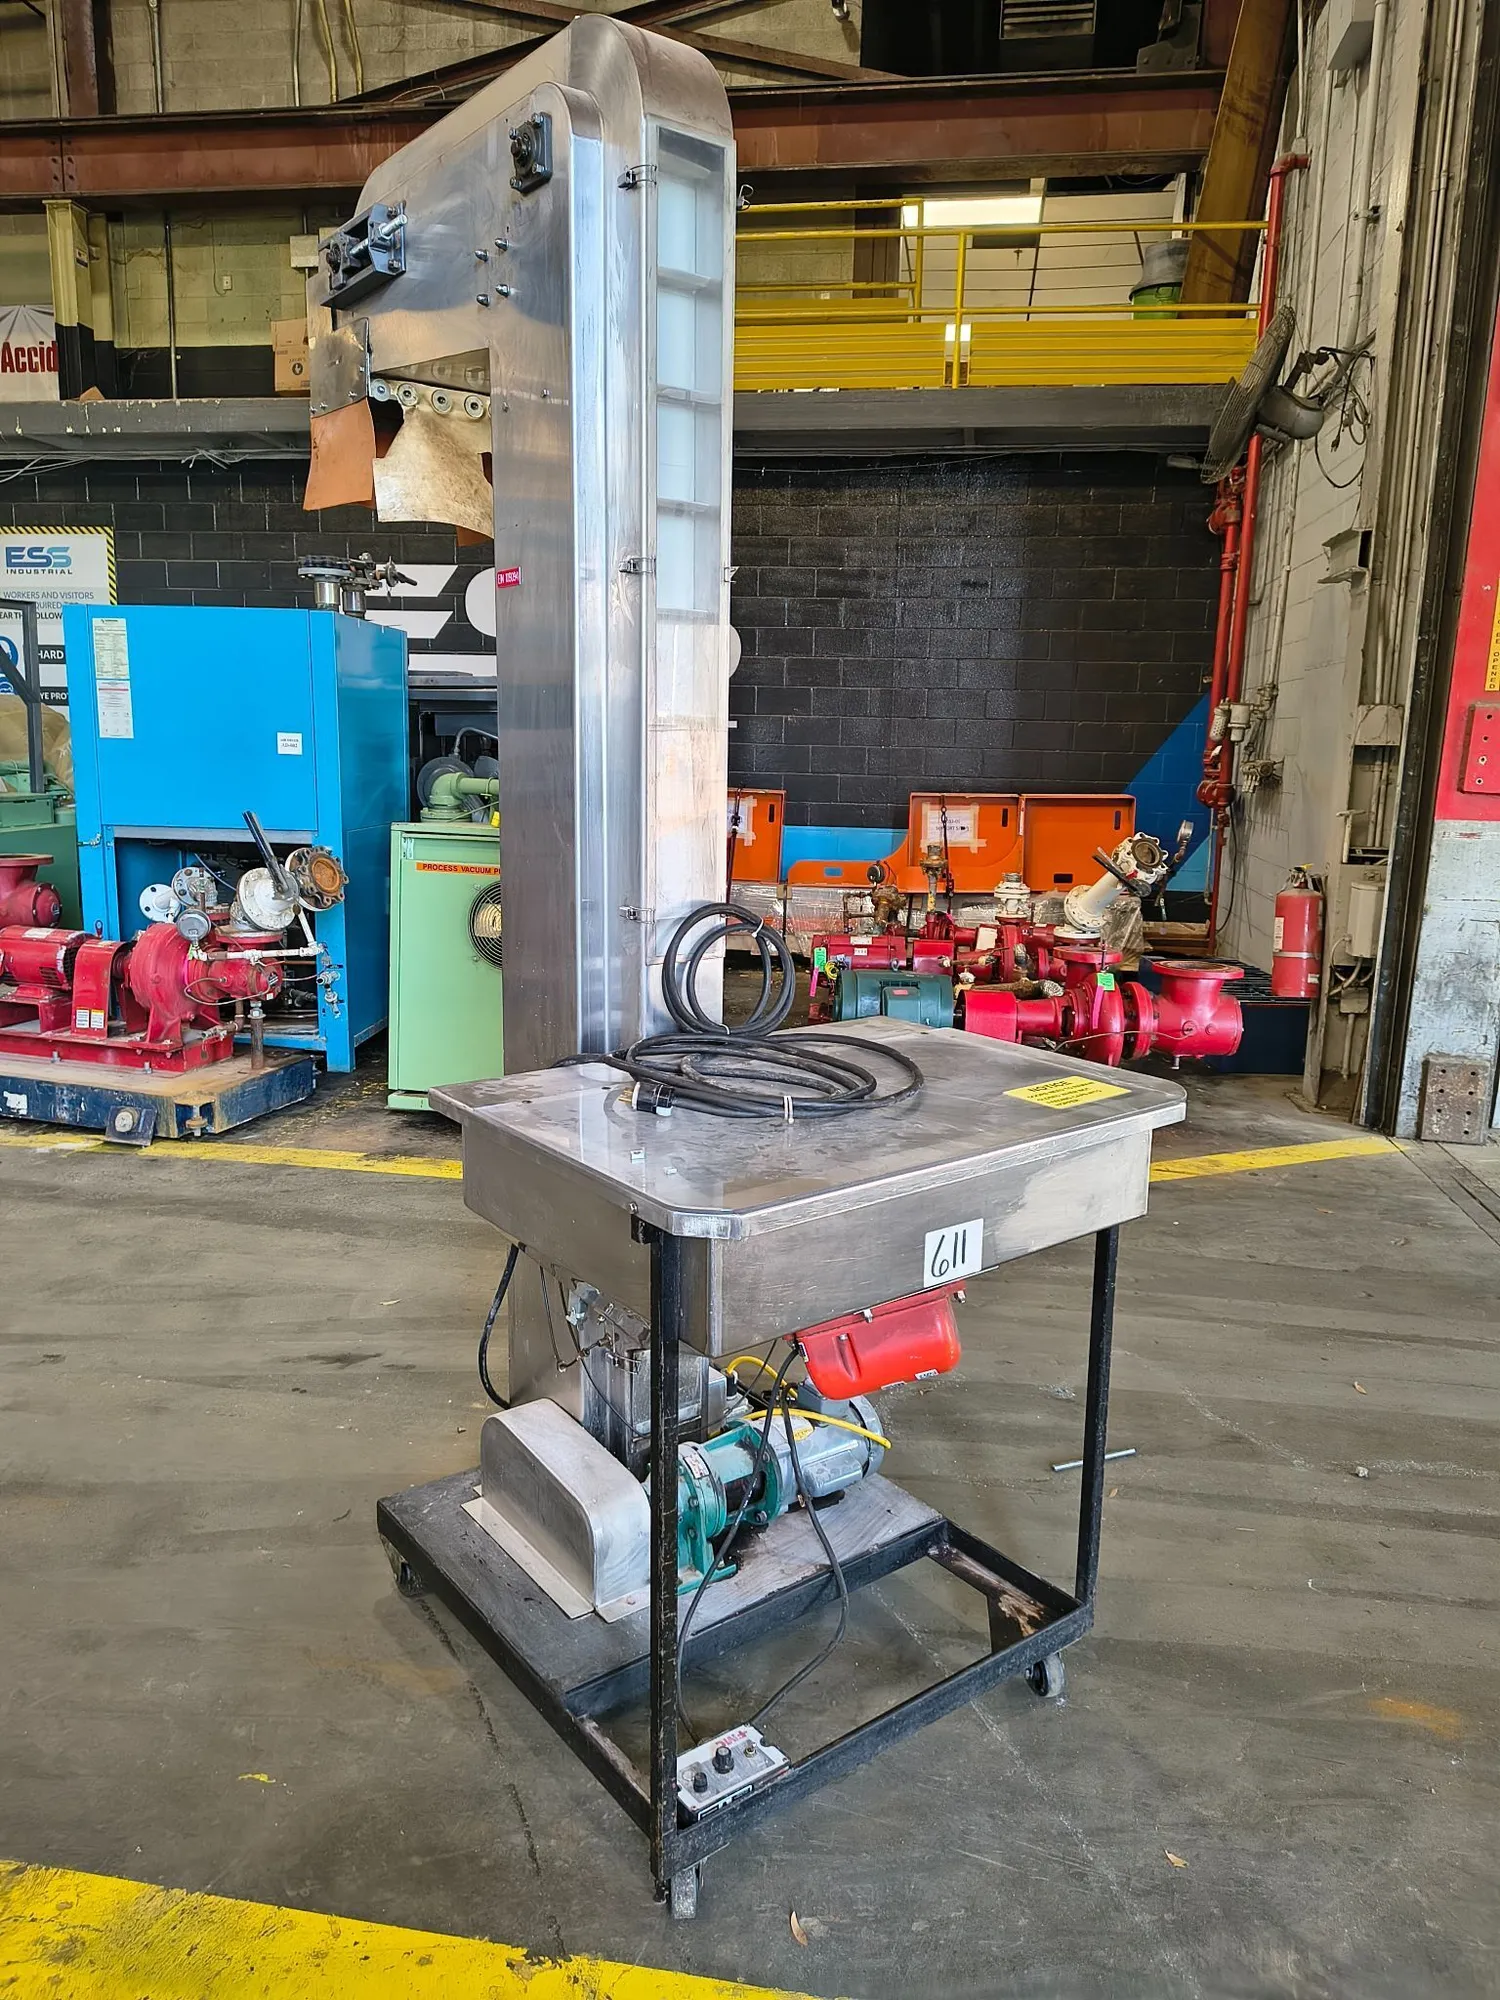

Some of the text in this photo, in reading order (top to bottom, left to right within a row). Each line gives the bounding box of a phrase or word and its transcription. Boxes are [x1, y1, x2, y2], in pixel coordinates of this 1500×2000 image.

[1, 341, 59, 373] Accid
[5, 546, 72, 568] ESS
[36, 601, 62, 610] QUIRED
[0, 612, 14, 620] EAR
[36, 612, 63, 620] OLLOW
[1489, 652, 1499, 689] OPENED
[40, 692, 50, 700] YE
[423, 864, 458, 872] PROCESS
[931, 1229, 967, 1278] 611
